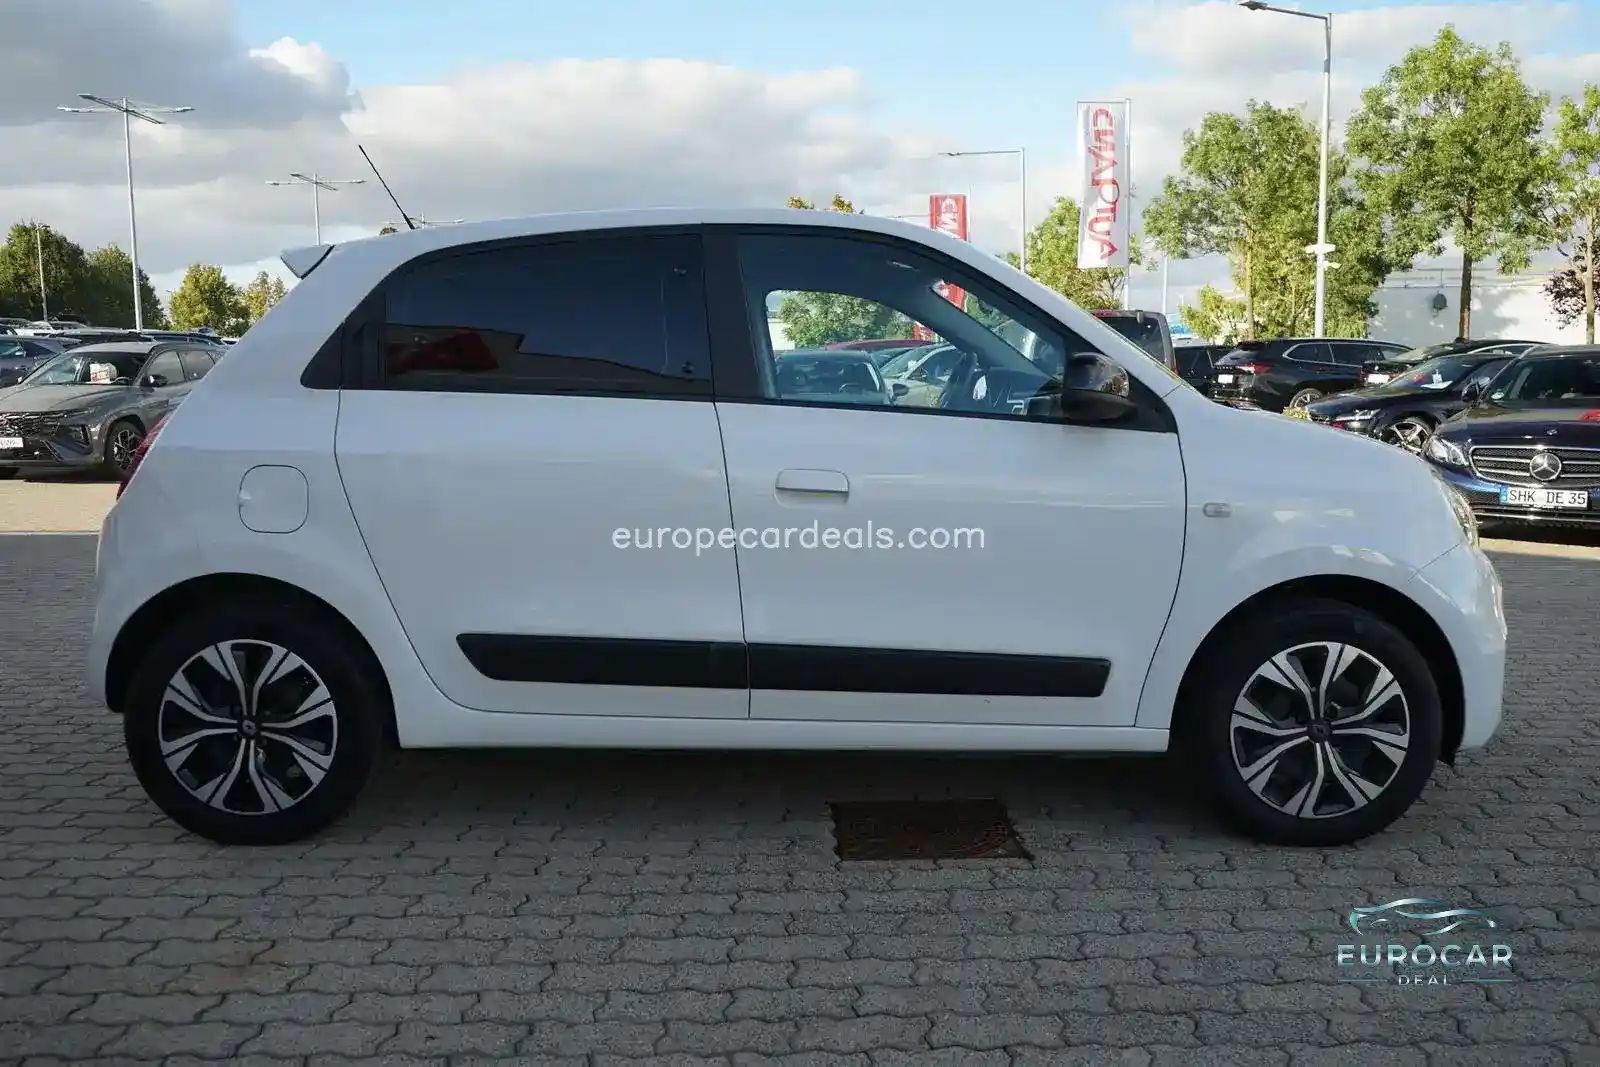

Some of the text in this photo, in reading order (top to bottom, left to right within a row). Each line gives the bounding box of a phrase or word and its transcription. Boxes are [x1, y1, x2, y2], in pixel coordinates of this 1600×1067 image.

[1509, 489, 1535, 502] SHK
[1546, 491, 1564, 504] DE
[1568, 492, 1586, 505] 35
